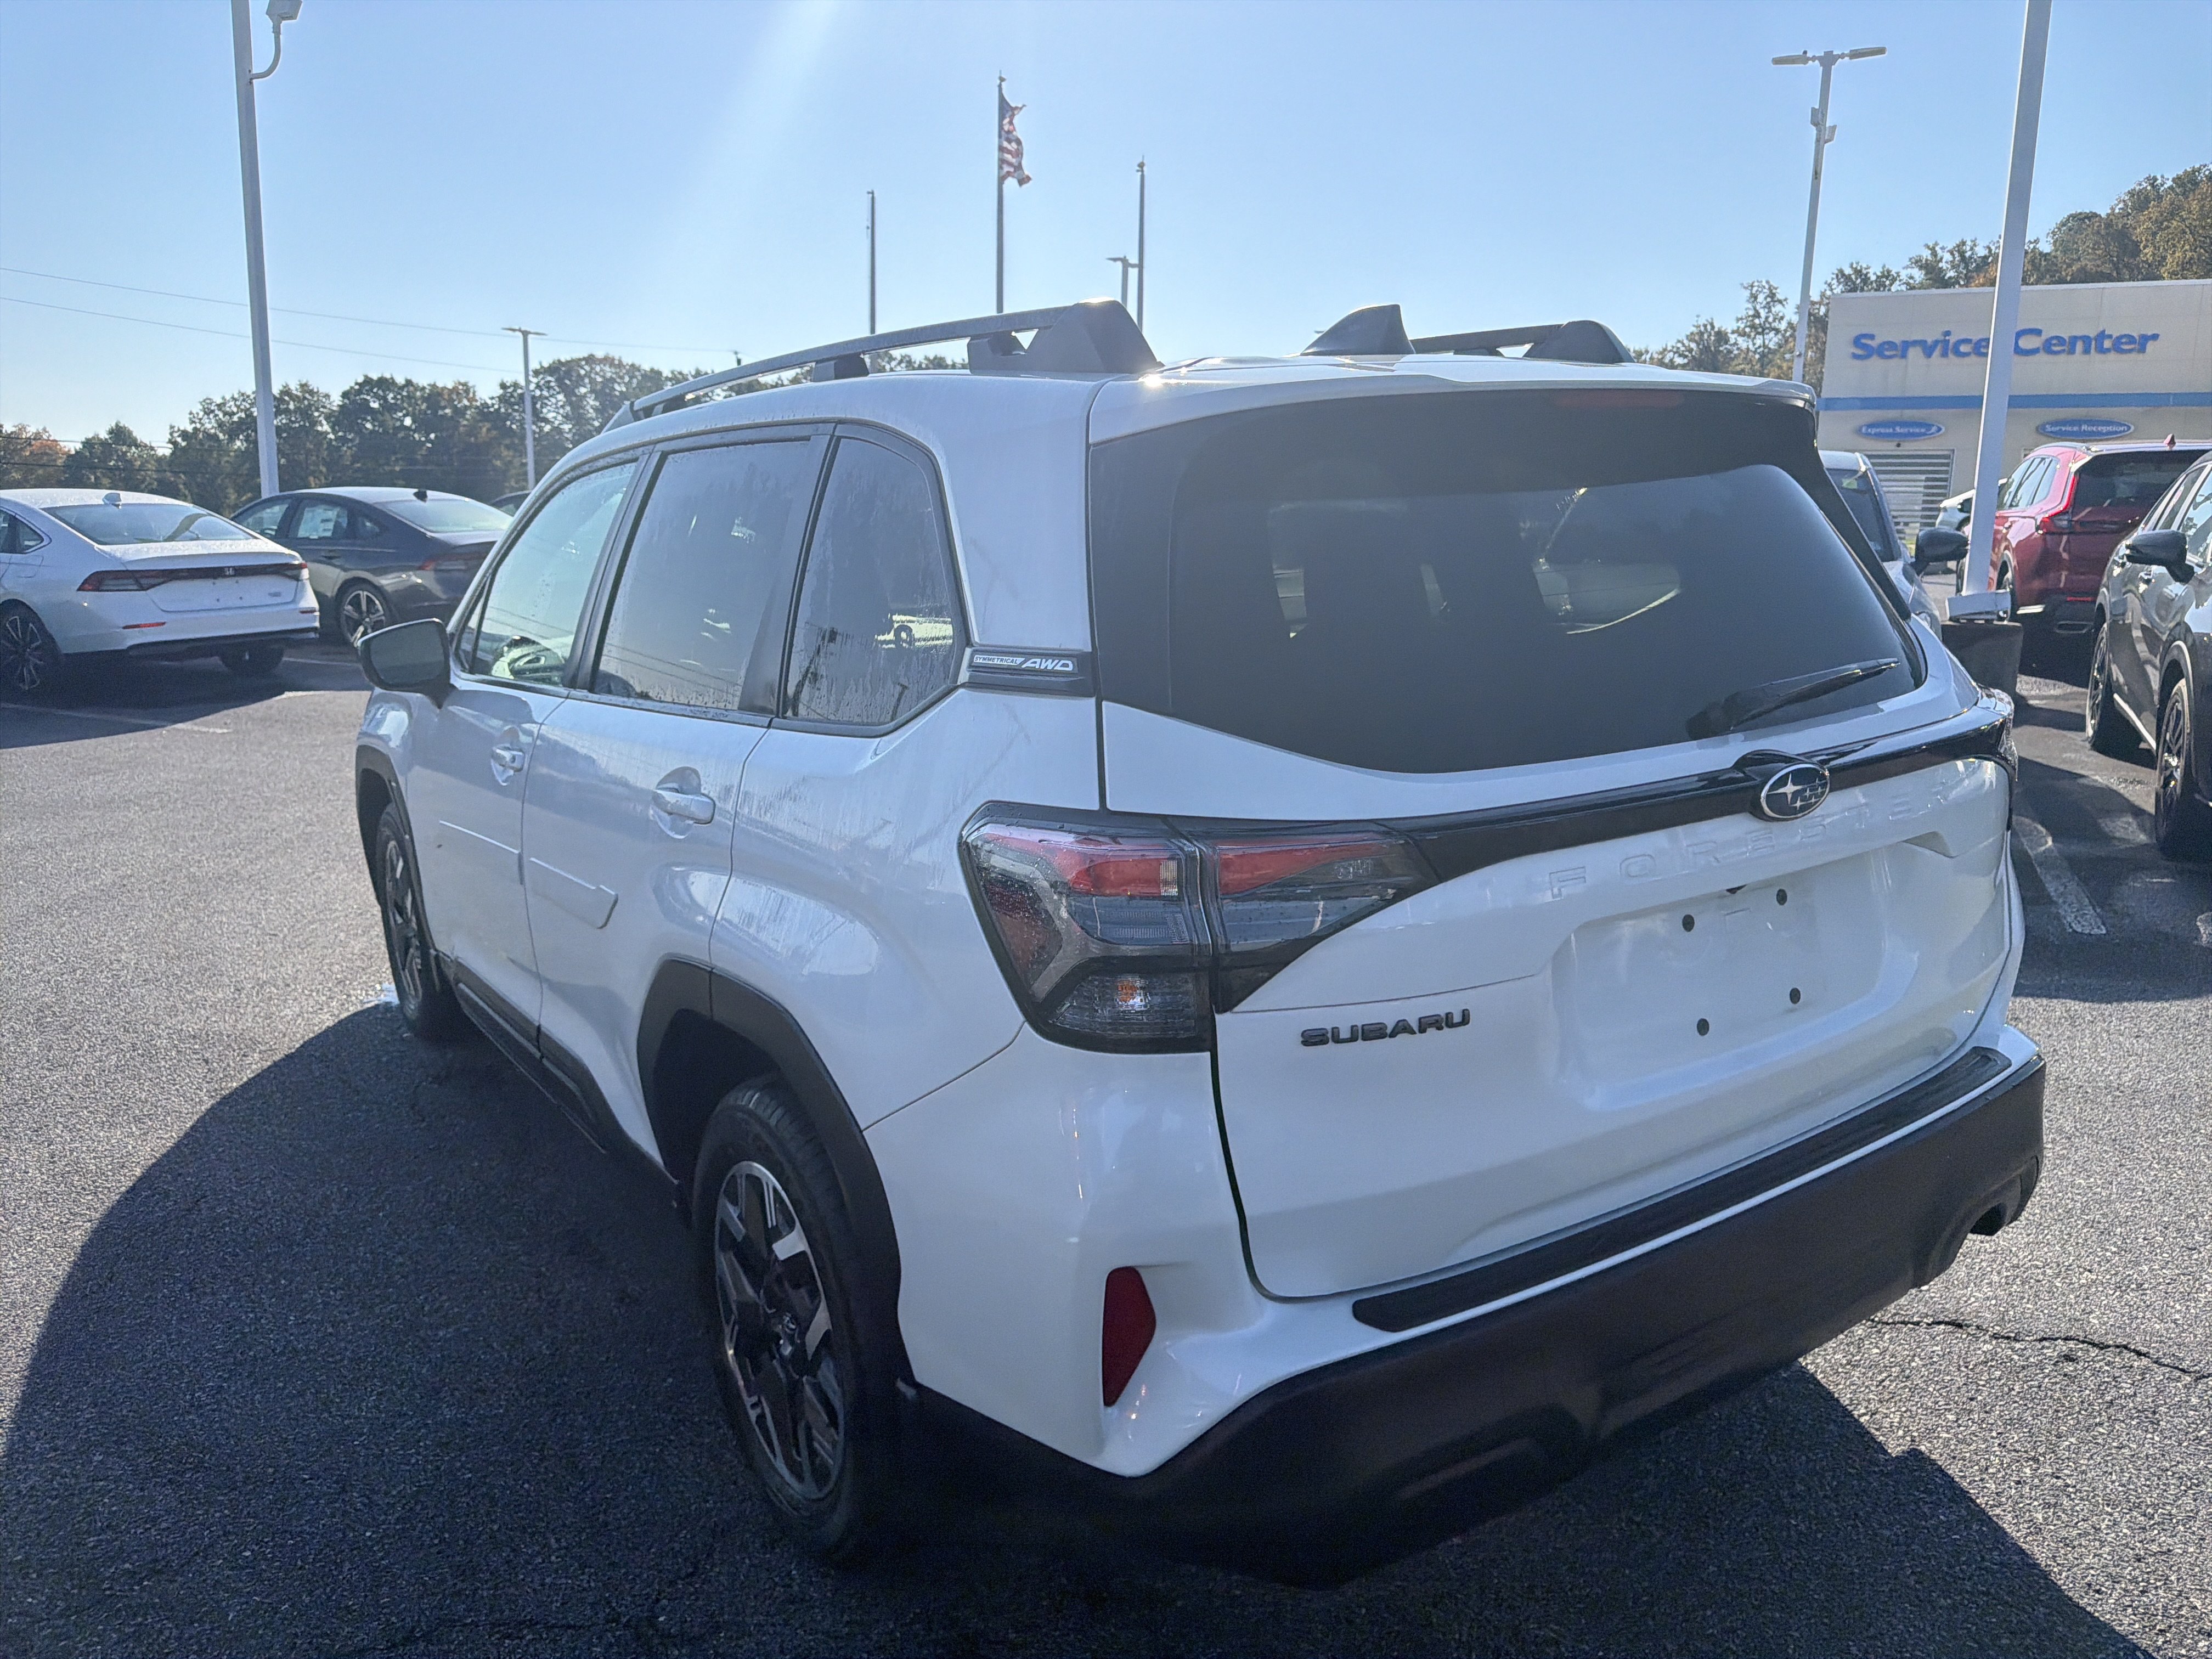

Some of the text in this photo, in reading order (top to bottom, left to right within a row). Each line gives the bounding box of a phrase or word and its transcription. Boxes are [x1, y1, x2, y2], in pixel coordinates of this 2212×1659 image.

[1851, 328, 2160, 360] Service Center
[974, 656, 1073, 670] SYMMETRICAL AWD
[1301, 1008, 1470, 1047] SUBARU
